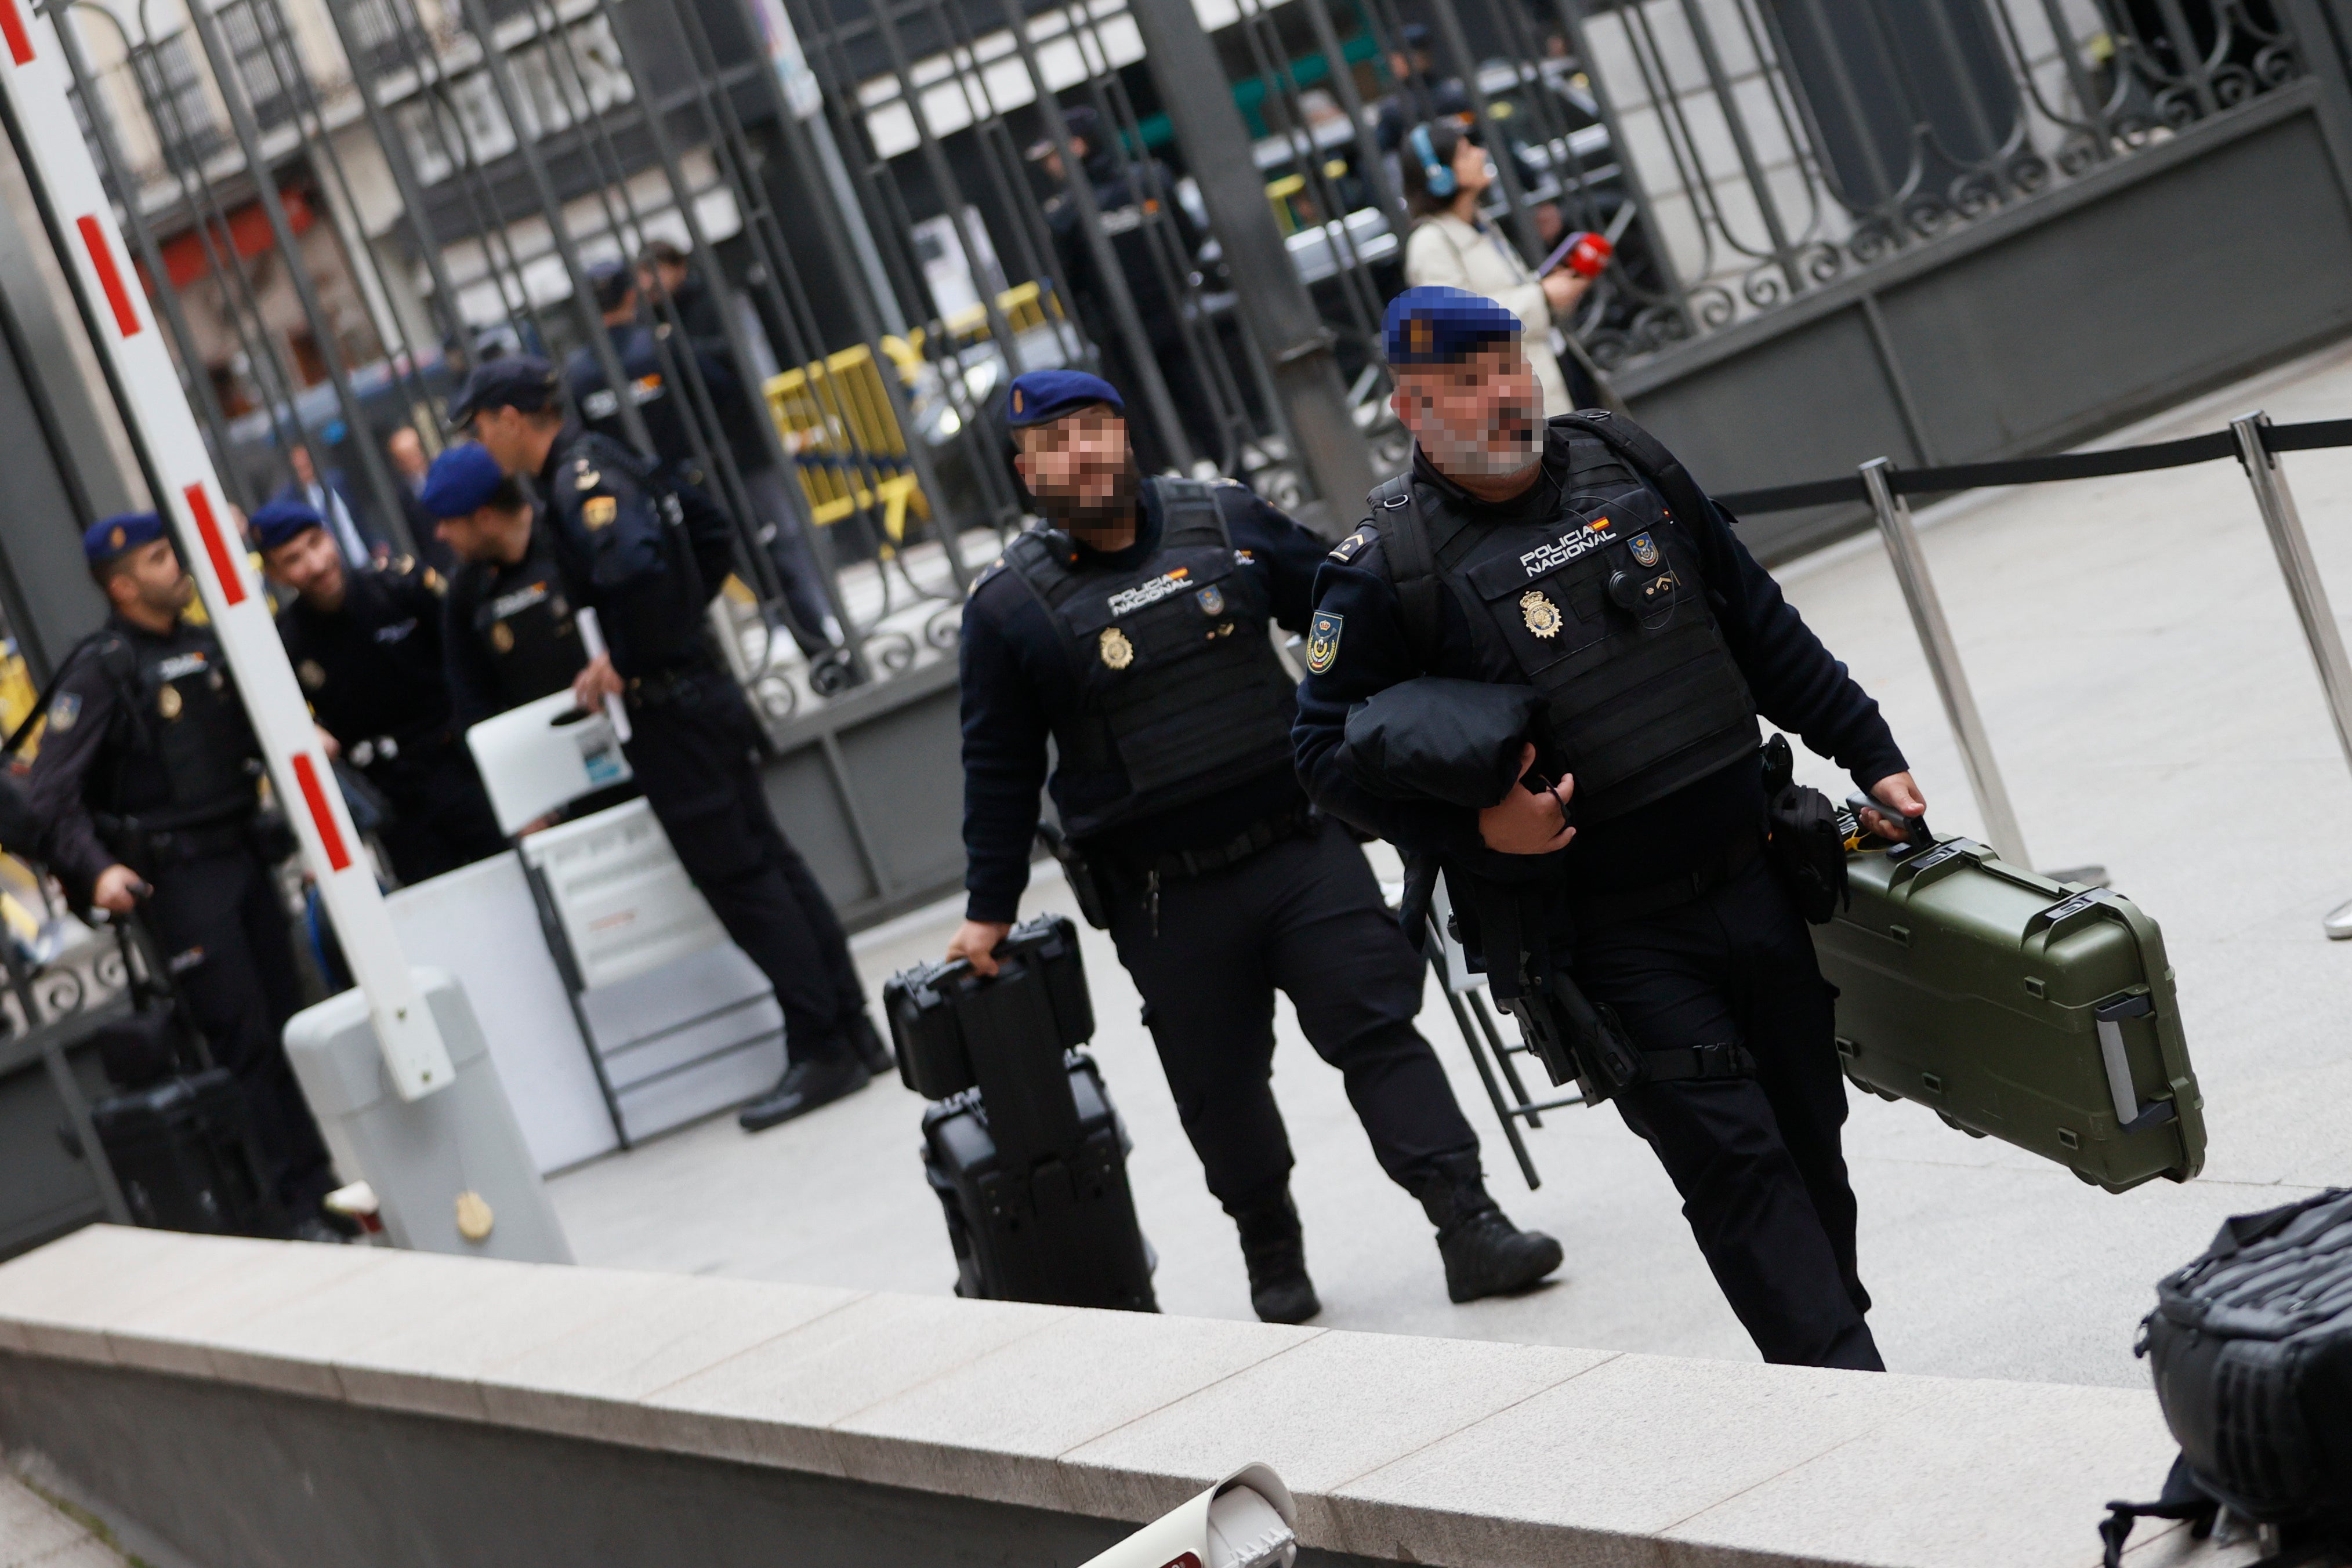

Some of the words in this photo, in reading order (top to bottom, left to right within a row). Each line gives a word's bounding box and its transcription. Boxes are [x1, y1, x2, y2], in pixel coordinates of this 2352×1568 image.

[1520, 525, 1594, 567] POLICIA
[1526, 531, 1617, 577] NACIONAL
[1107, 574, 1173, 608] POLICIA
[1112, 578, 1193, 616] NACIONAL
